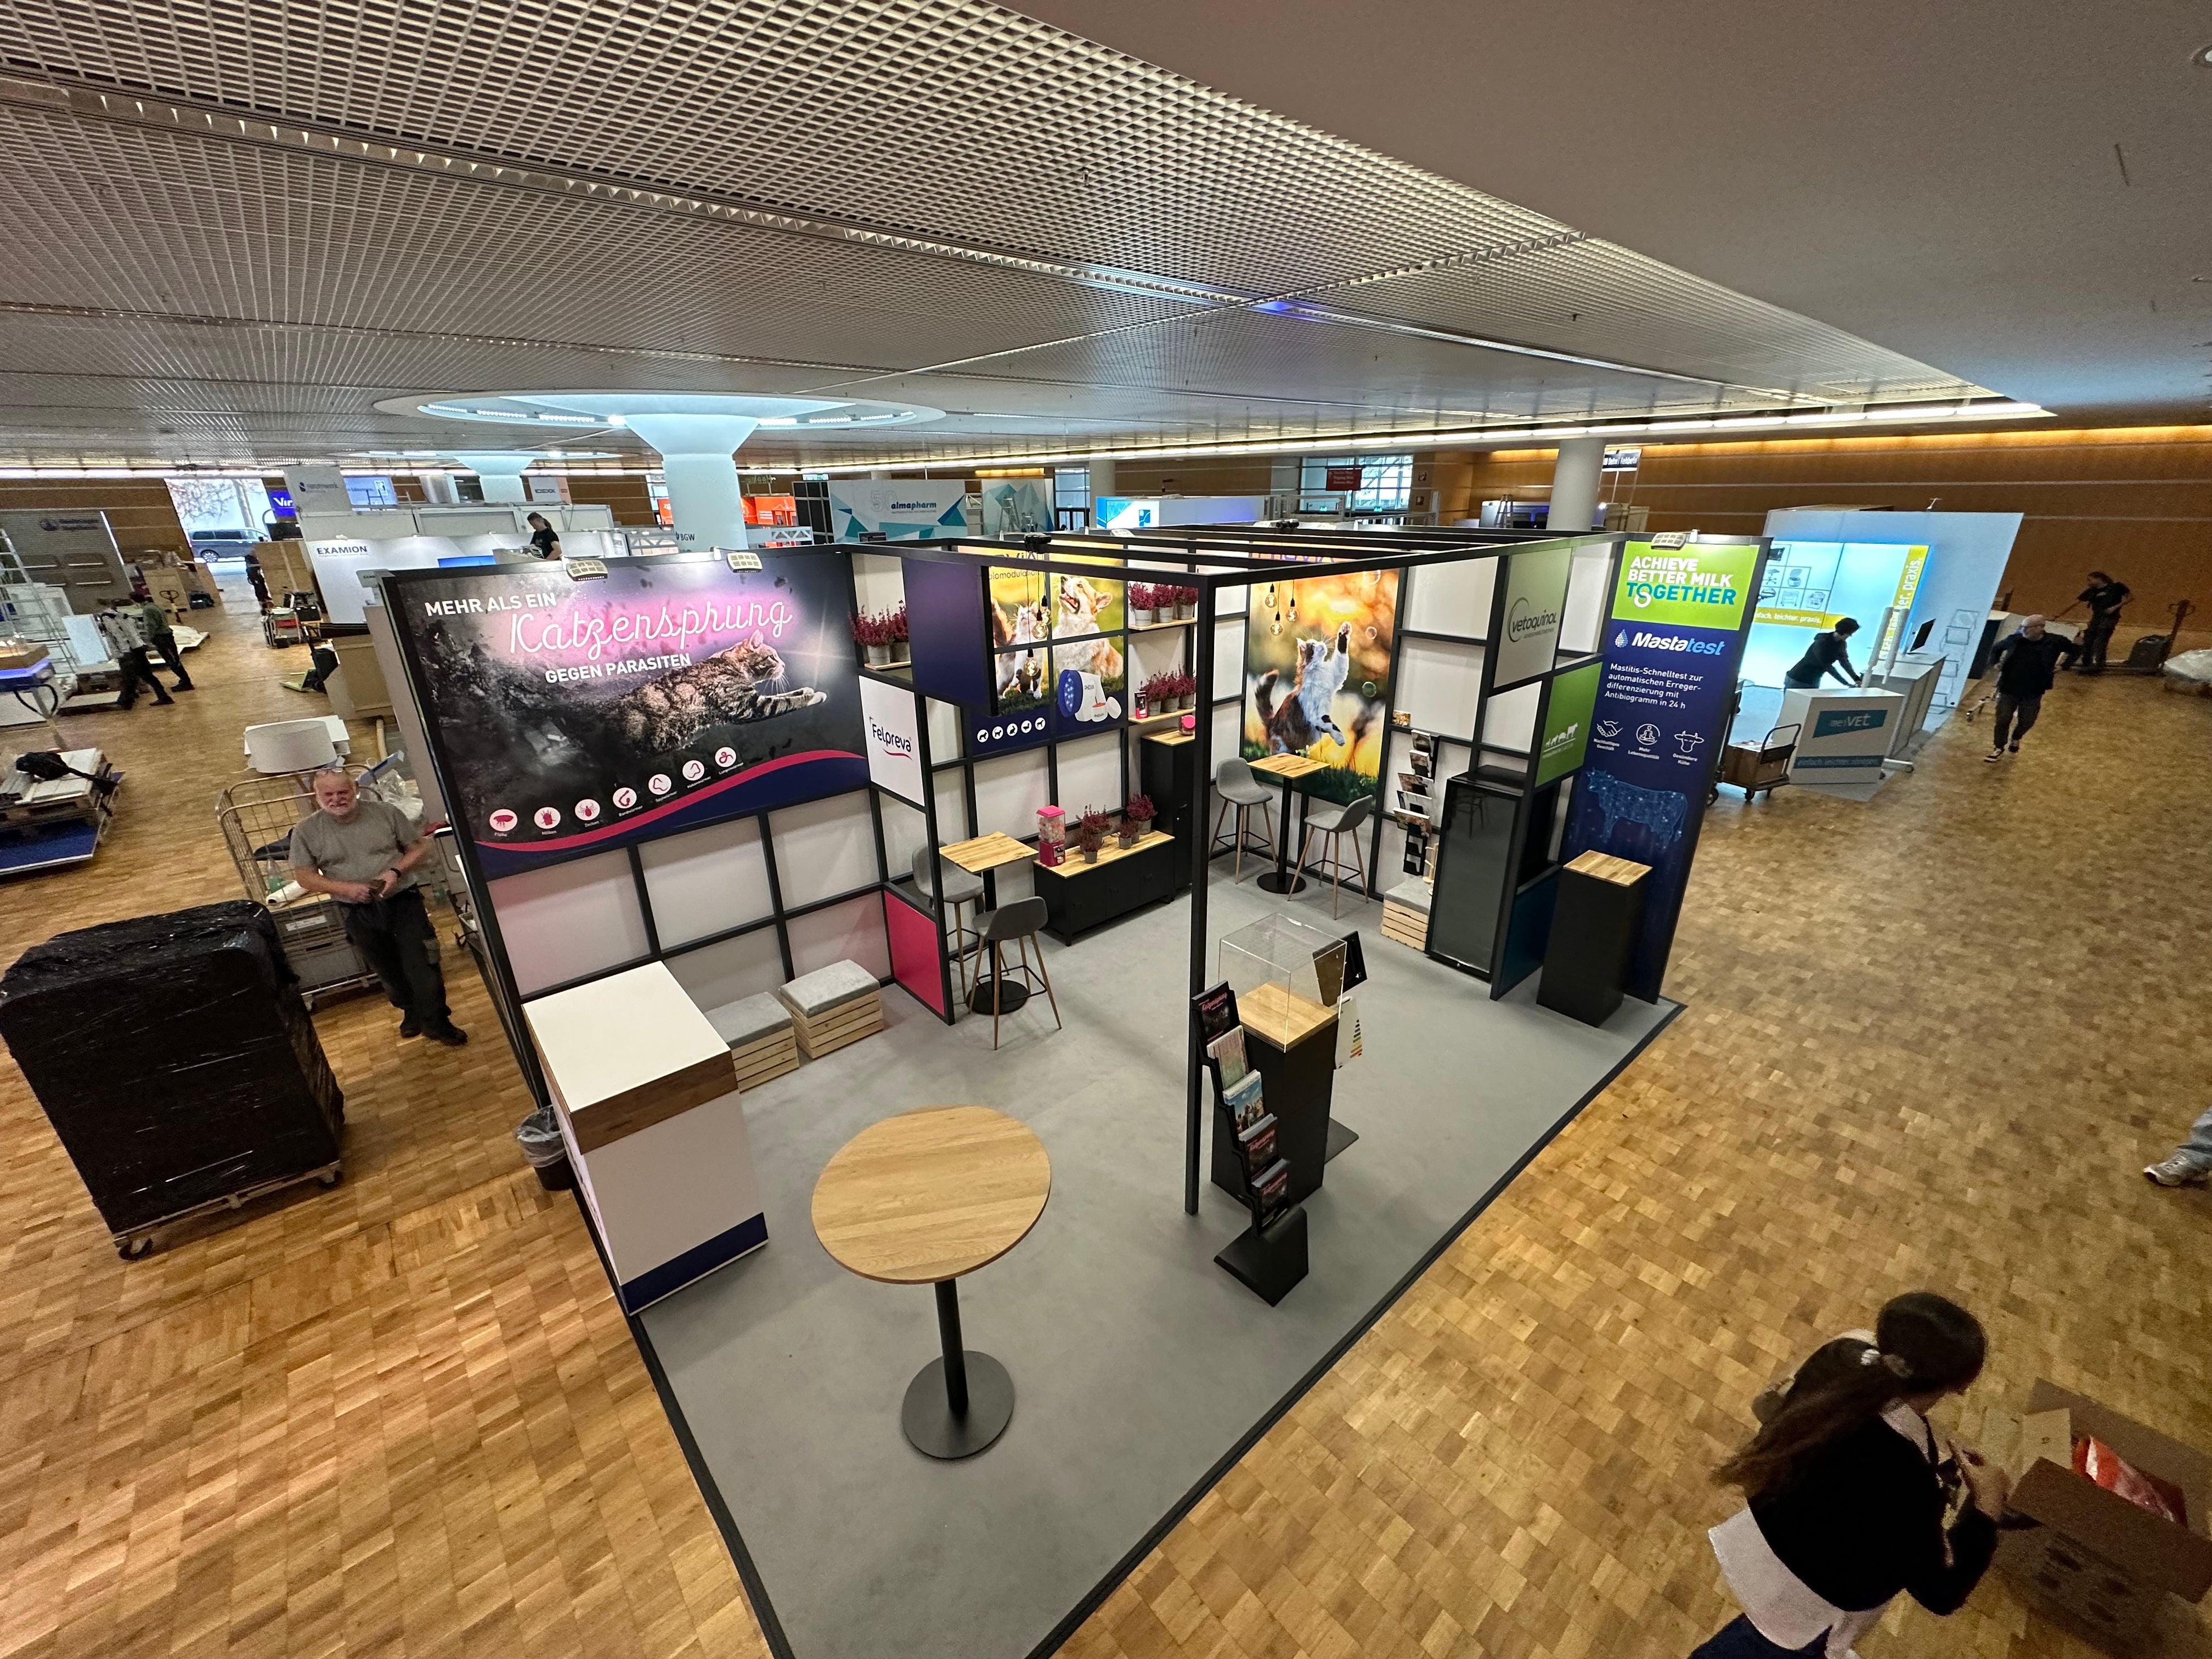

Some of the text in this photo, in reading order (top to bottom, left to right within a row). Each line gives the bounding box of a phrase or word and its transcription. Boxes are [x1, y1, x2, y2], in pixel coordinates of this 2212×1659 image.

[273, 497, 294, 506] Vir
[891, 501, 936, 510] almapharm
[317, 545, 368, 555] EXAMION
[1630, 556, 1700, 572] ACHIEVE
[1627, 569, 1734, 588] BETTER MILK
[1627, 582, 1737, 605] TOGETHER
[425, 592, 557, 617] MEHR ALS EIN
[510, 600, 793, 661] Katzensprung
[1631, 632, 1725, 656] Mastatest
[545, 653, 693, 684] GEGEN PARASITEN
[1610, 663, 1688, 680] Mastitis-Schnelltest
[1606, 681, 1664, 698] differenzierung
[1608, 673, 1702, 692] automatischen Erreger-
[1604, 691, 1658, 706] Antibiogramm
[872, 723, 912, 753] Felpreva
